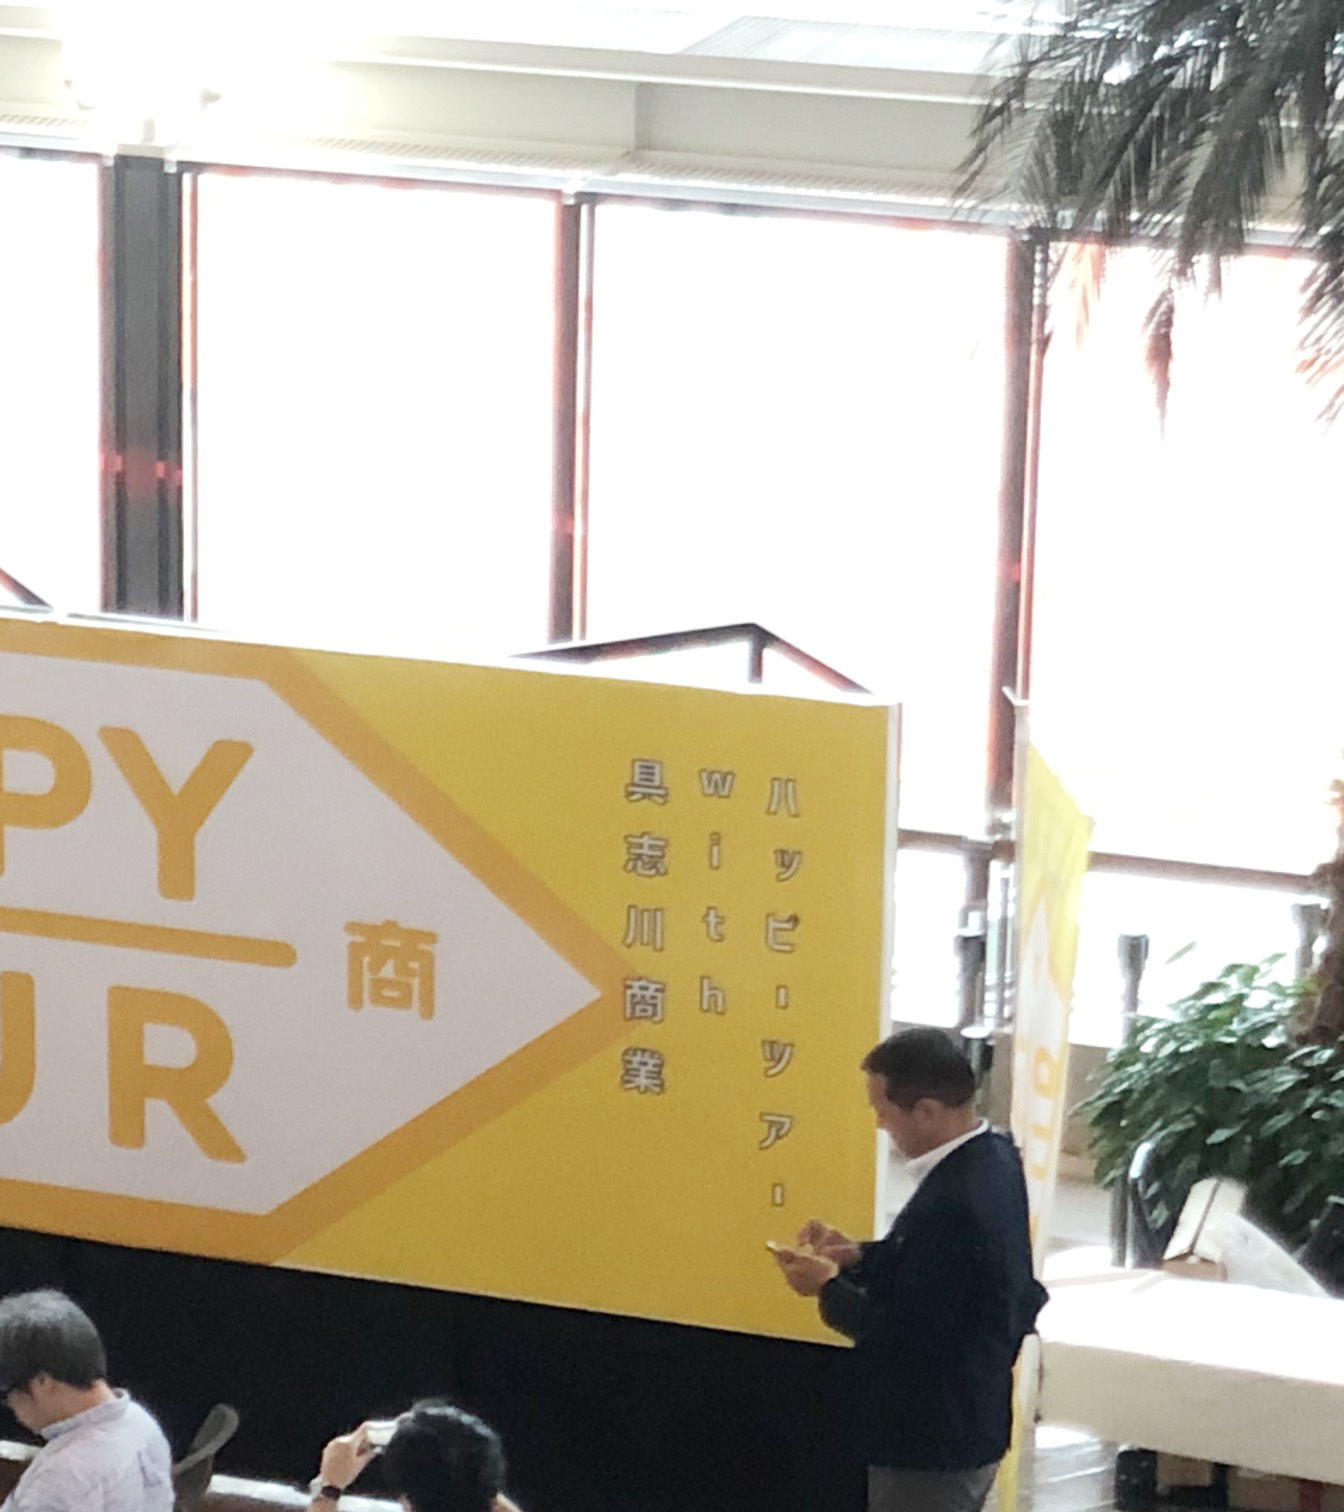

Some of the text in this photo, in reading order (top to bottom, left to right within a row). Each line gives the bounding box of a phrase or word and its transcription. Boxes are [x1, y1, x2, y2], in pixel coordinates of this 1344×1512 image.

[345, 920, 439, 1021] 商
[621, 758, 668, 1095] 具志川商業
[758, 777, 802, 1207] ハッピーツアー
